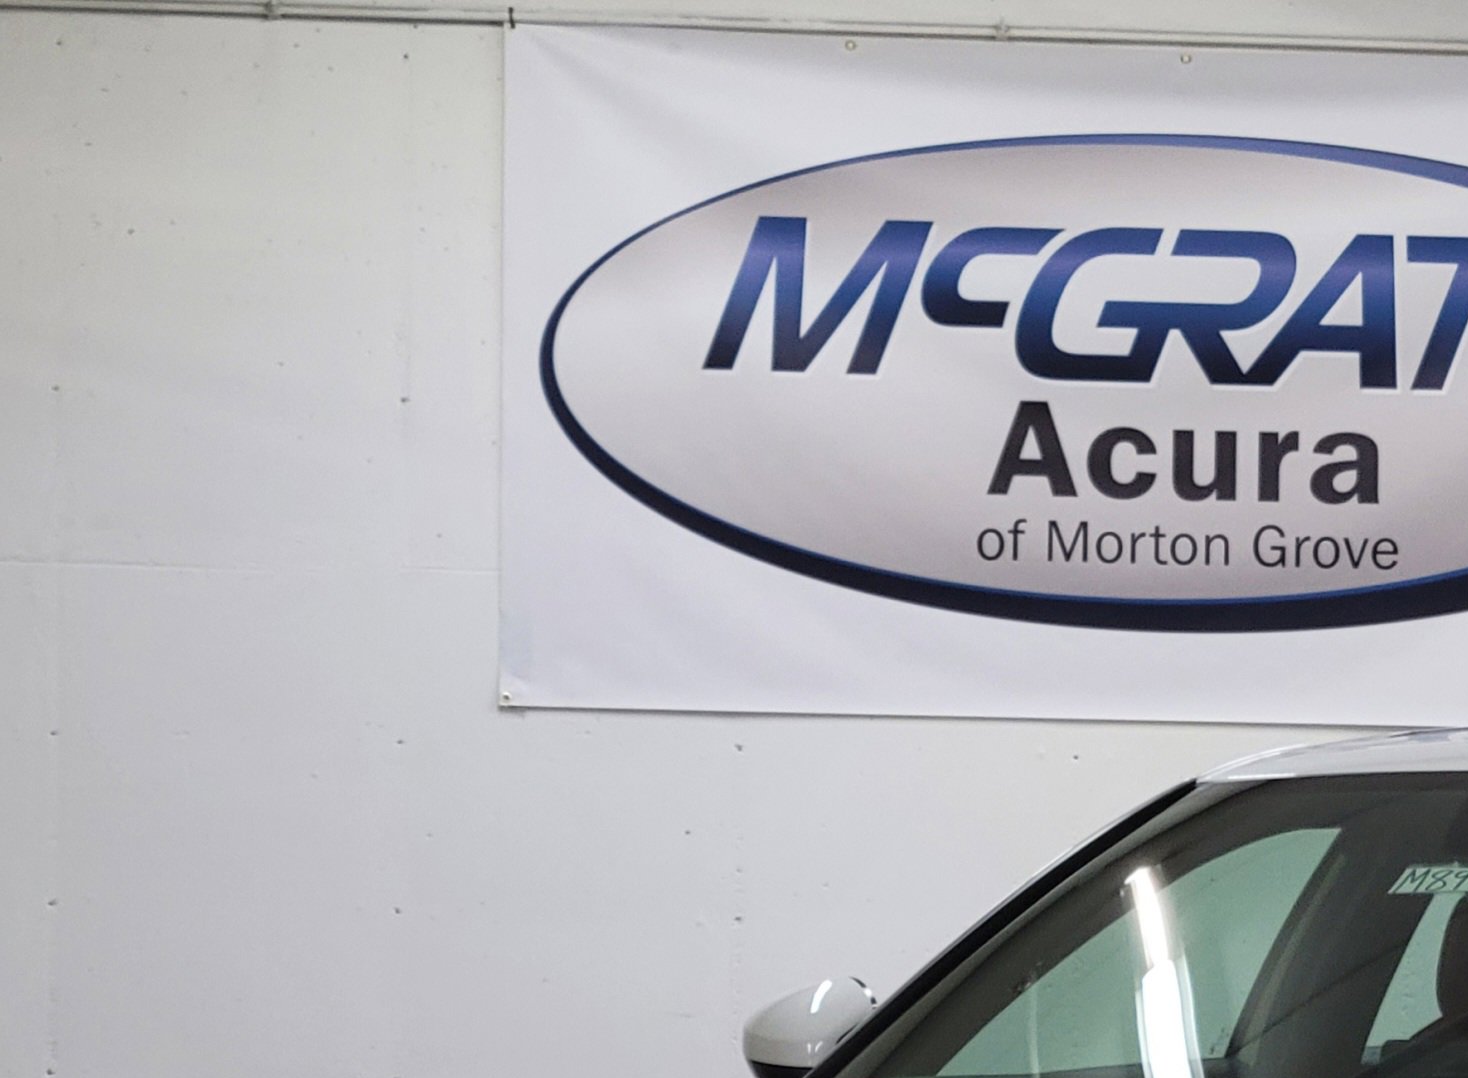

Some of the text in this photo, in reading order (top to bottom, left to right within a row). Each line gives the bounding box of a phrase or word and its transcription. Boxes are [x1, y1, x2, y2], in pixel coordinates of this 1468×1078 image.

[987, 400, 1381, 505] Acura
[976, 518, 1400, 571] of Morton Grove
